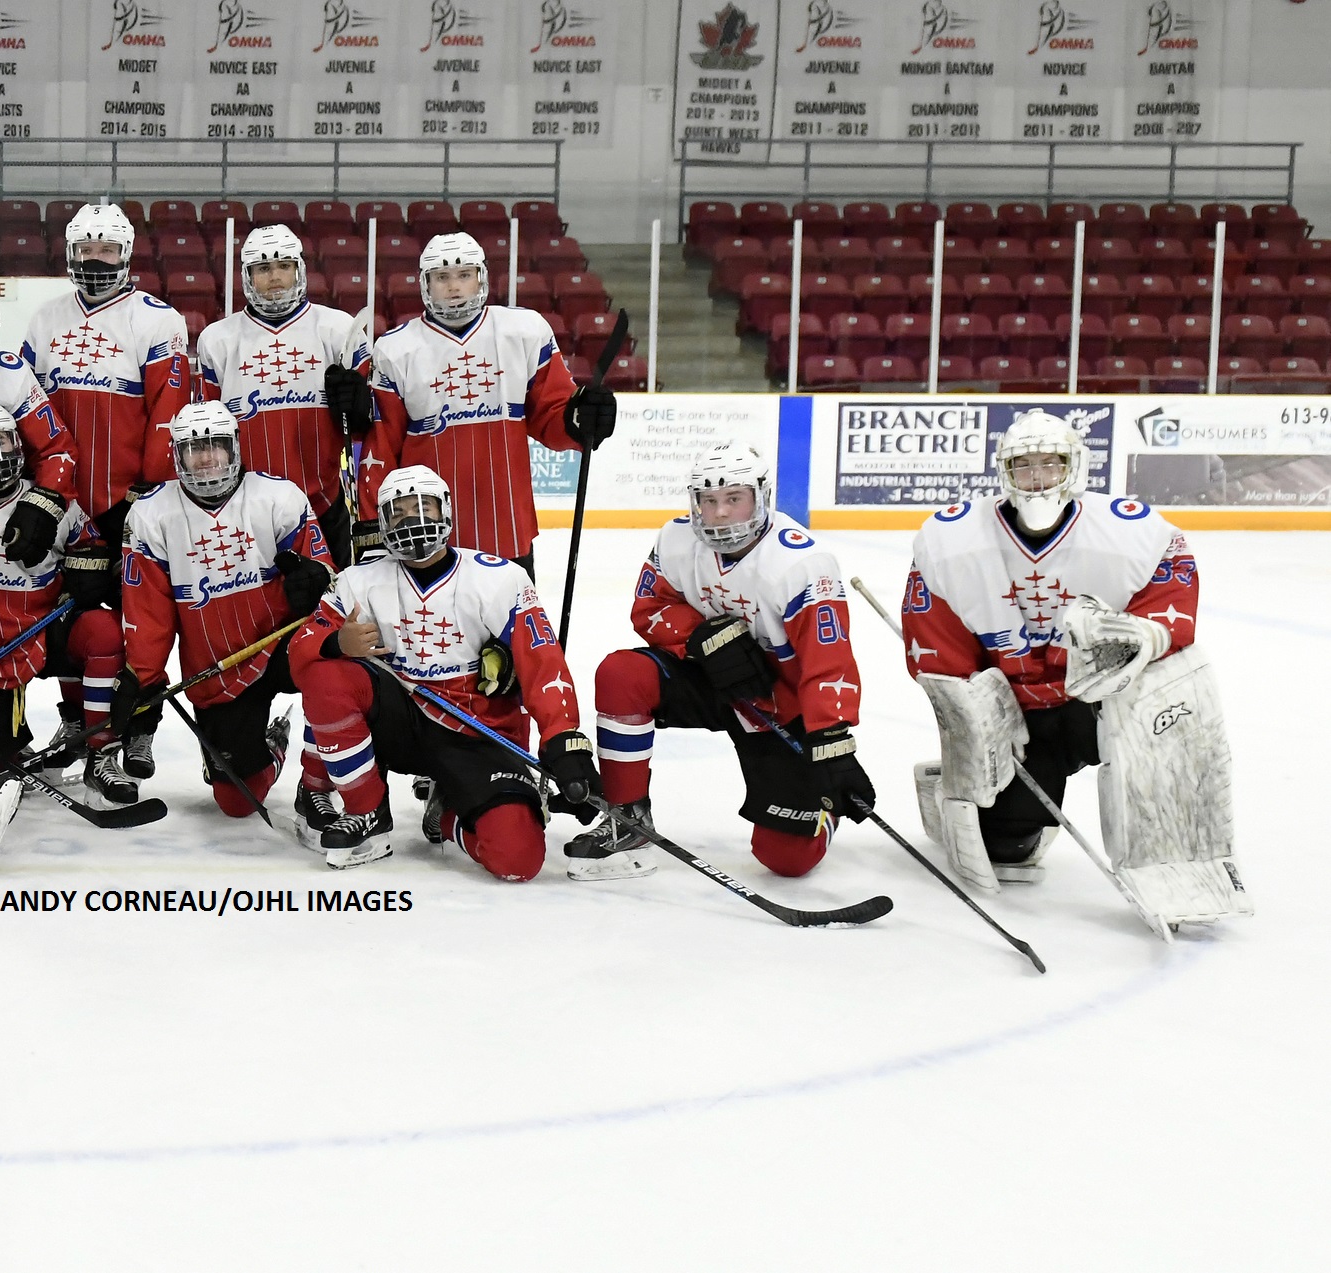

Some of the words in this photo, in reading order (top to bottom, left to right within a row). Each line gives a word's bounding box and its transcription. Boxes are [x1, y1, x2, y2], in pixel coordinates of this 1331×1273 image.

[123, 34, 165, 46] OMHA
[228, 37, 272, 48] OMHA
[334, 36, 379, 47] OMHA
[119, 59, 157, 72] MIDGET
[210, 61, 247, 74] NOVICE
[252, 62, 278, 75] EAST
[325, 60, 375, 73] JUVENILE
[433, 59, 480, 73] JUVENILE
[534, 60, 570, 73] NOVICE
[805, 61, 860, 74] JUVENILE
[901, 62, 942, 75] MINOR
[1043, 62, 1086, 76] NOVICE
[133, 81, 140, 94] A
[236, 82, 249, 95] AA
[346, 81, 353, 94] A
[452, 80, 459, 93] A
[690, 92, 757, 106] CHAMPIONS
[105, 101, 165, 115] CHAMPIONS
[211, 103, 273, 117] CHAMPIONS
[317, 102, 381, 115] CHAMPIONS
[425, 100, 485, 113] CHAMPIONS
[535, 101, 598, 114] CHAMPIONS
[795, 101, 866, 115] CHAMPIONS
[912, 103, 979, 116] CHAMPIONS
[1027, 103, 1098, 117] CHAMPIONS
[3, 124, 31, 137] 2016
[101, 122, 128, 134] 2014
[140, 123, 166, 136] 2015
[208, 124, 235, 137] 2014
[248, 125, 274, 138] 2015
[315, 122, 342, 135] 2013
[355, 122, 382, 135] 2014
[423, 120, 447, 133] 2012
[170, 356, 181, 388] 5
[47, 366, 112, 394] Snowbirds
[237, 389, 316, 421] Snowbirds
[430, 404, 503, 436] Snowbirds
[620, 411, 638, 420] The
[642, 408, 675, 421] ONE
[848, 410, 982, 430] BRANCH
[648, 425, 686, 435] Perfect
[1152, 419, 1268, 446] CONSUMERS
[630, 438, 675, 448] Window
[847, 434, 980, 454] ELECTRIC
[840, 475, 913, 487] INDUSTRIAL
[915, 475, 959, 488] DRIVES
[1245, 489, 1273, 501] More
[1275, 489, 1297, 501] than
[63, 556, 110, 571] ARRIOR
[182, 571, 259, 610] Snowbids
[23, 775, 73, 809] BAUER
[766, 803, 821, 823] BAUER
[691, 858, 754, 898] BAUER
